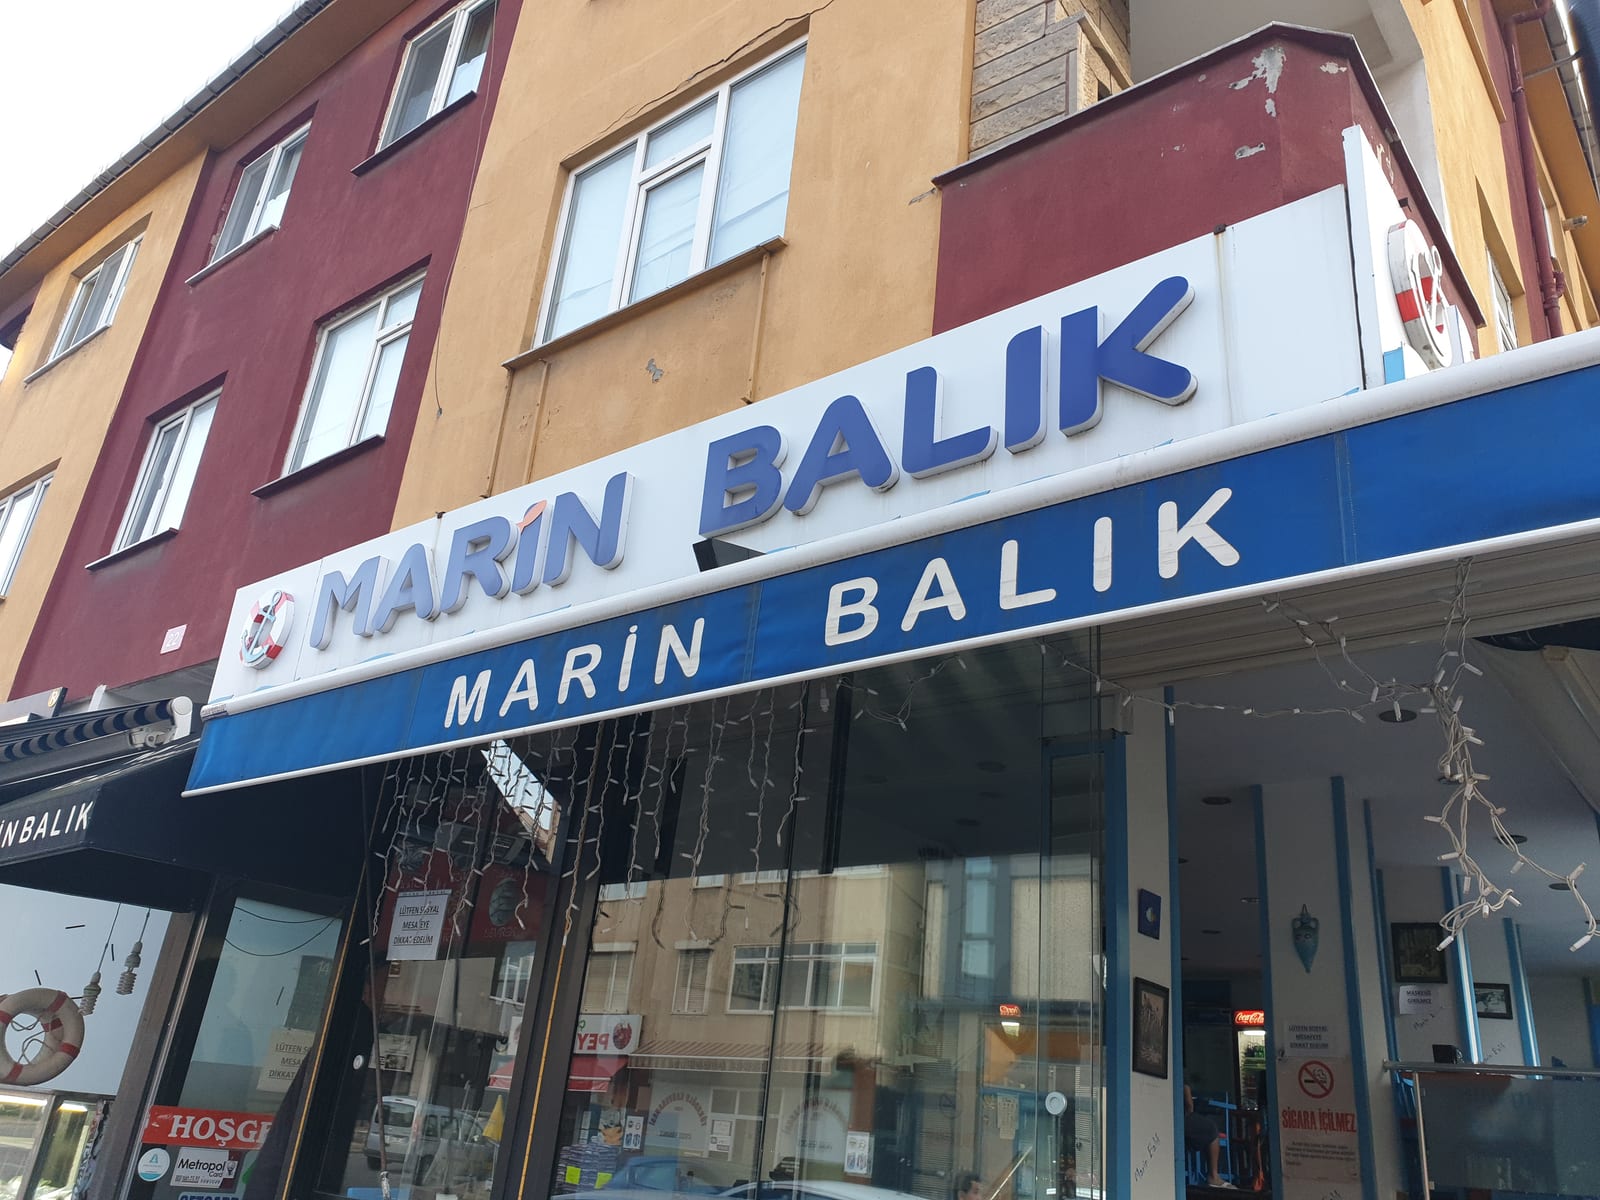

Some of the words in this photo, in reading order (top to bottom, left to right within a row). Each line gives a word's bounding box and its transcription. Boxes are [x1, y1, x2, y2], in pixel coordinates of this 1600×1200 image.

[699, 275, 1198, 538] BALIK
[443, 617, 705, 729] MARİN
[824, 487, 1241, 647] BALIK
[402, 919, 431, 929] MESAEYE
[281, 1057, 301, 1066] MESA
[1281, 1106, 1317, 1130] SİGARA
[1318, 1108, 1357, 1134] İÇİLMEZ
[177, 1158, 227, 1173] Metropol
